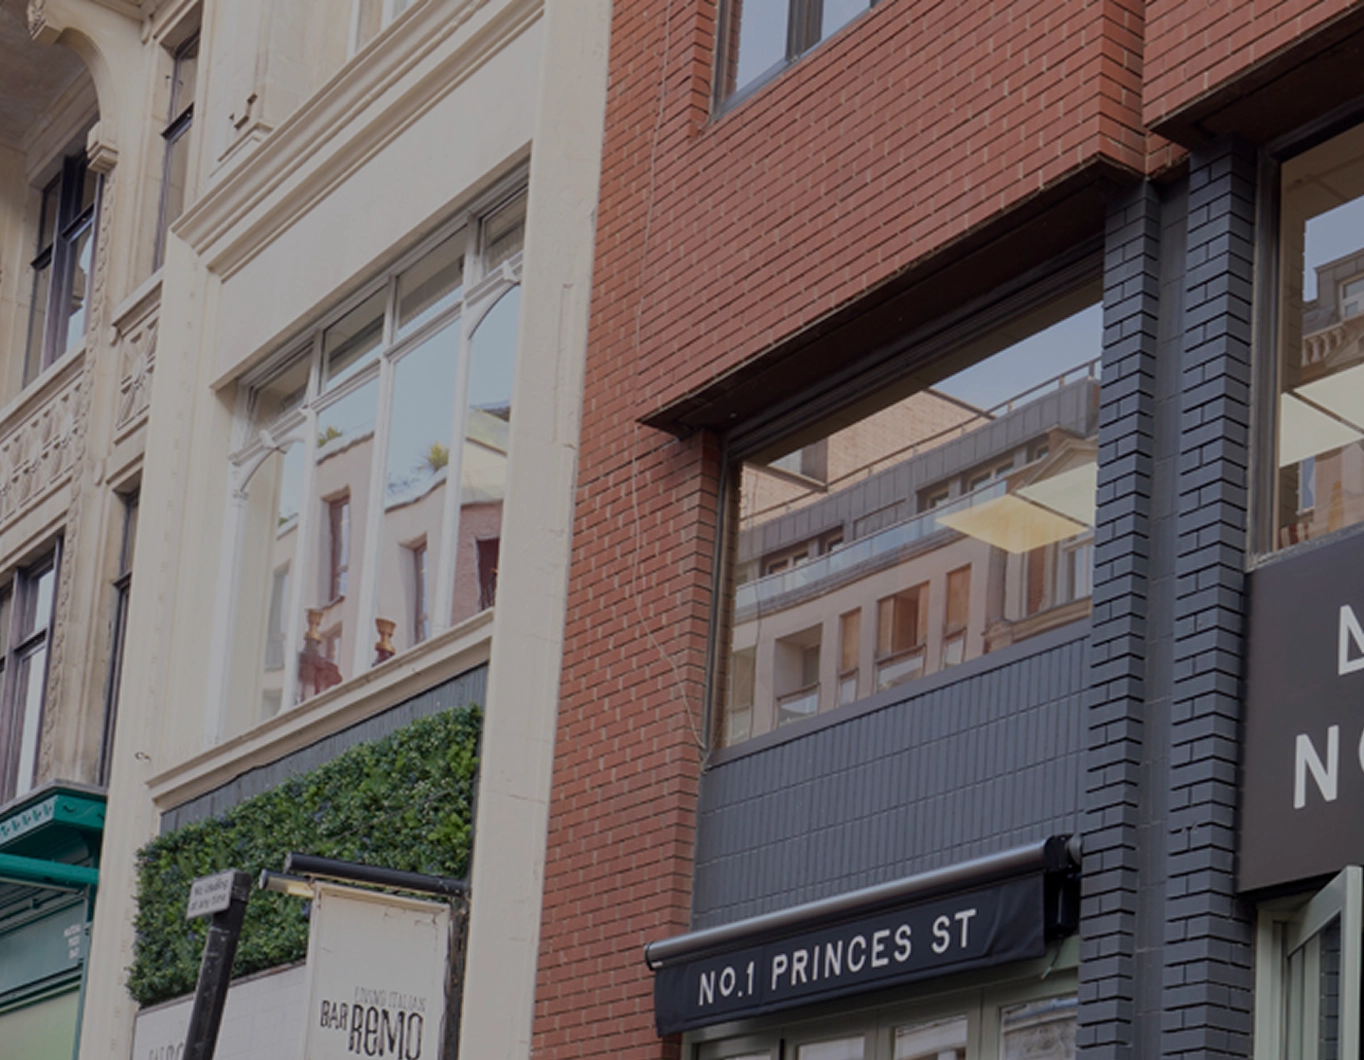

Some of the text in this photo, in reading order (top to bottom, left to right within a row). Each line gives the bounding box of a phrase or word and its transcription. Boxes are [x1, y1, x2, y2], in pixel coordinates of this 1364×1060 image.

[698, 907, 978, 1007] NO.1 PRINCES ST
[320, 1000, 349, 1031] BAR
